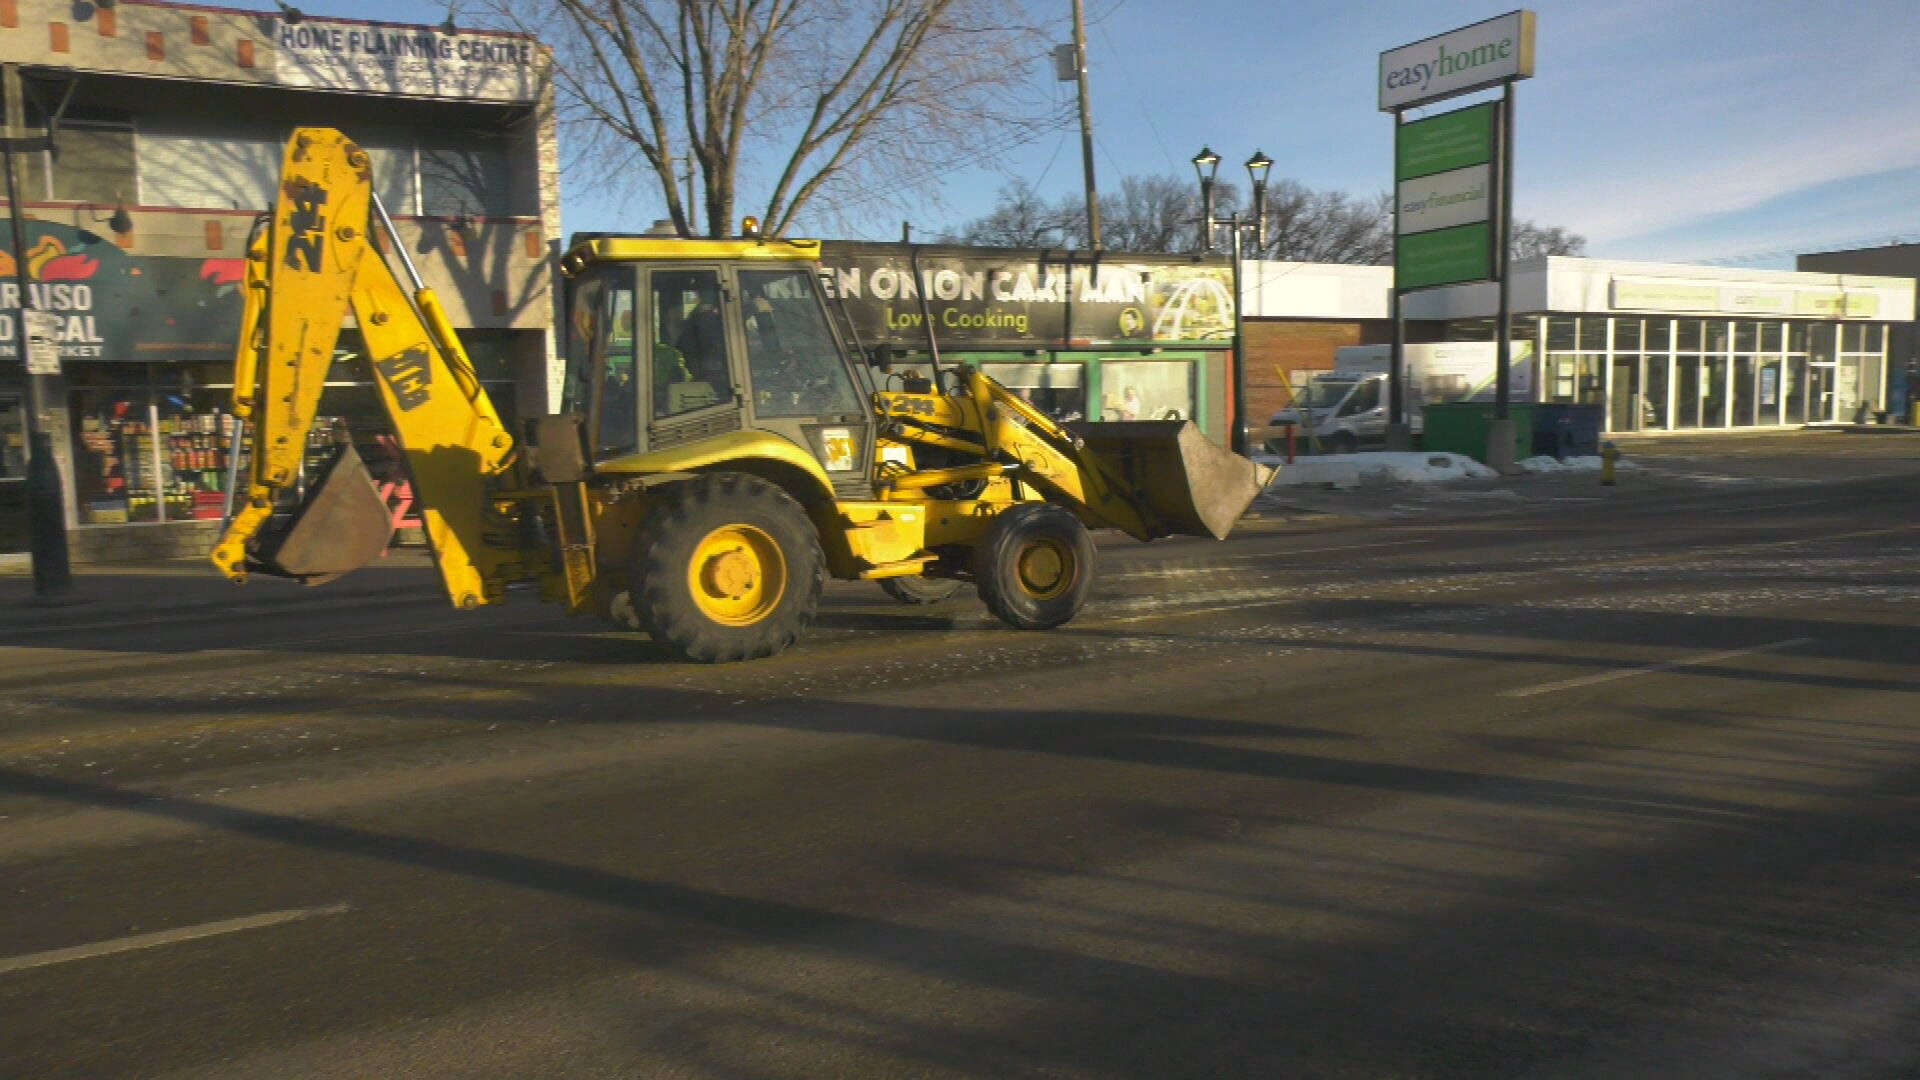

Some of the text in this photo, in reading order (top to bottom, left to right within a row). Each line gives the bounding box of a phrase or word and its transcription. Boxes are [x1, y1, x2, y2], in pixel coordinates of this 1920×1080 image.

[281, 27, 531, 64] HOME PLANNING CENTRE
[1387, 37, 1512, 90] easyhome
[870, 270, 984, 301] ONION
[943, 308, 1028, 332] Cooking
